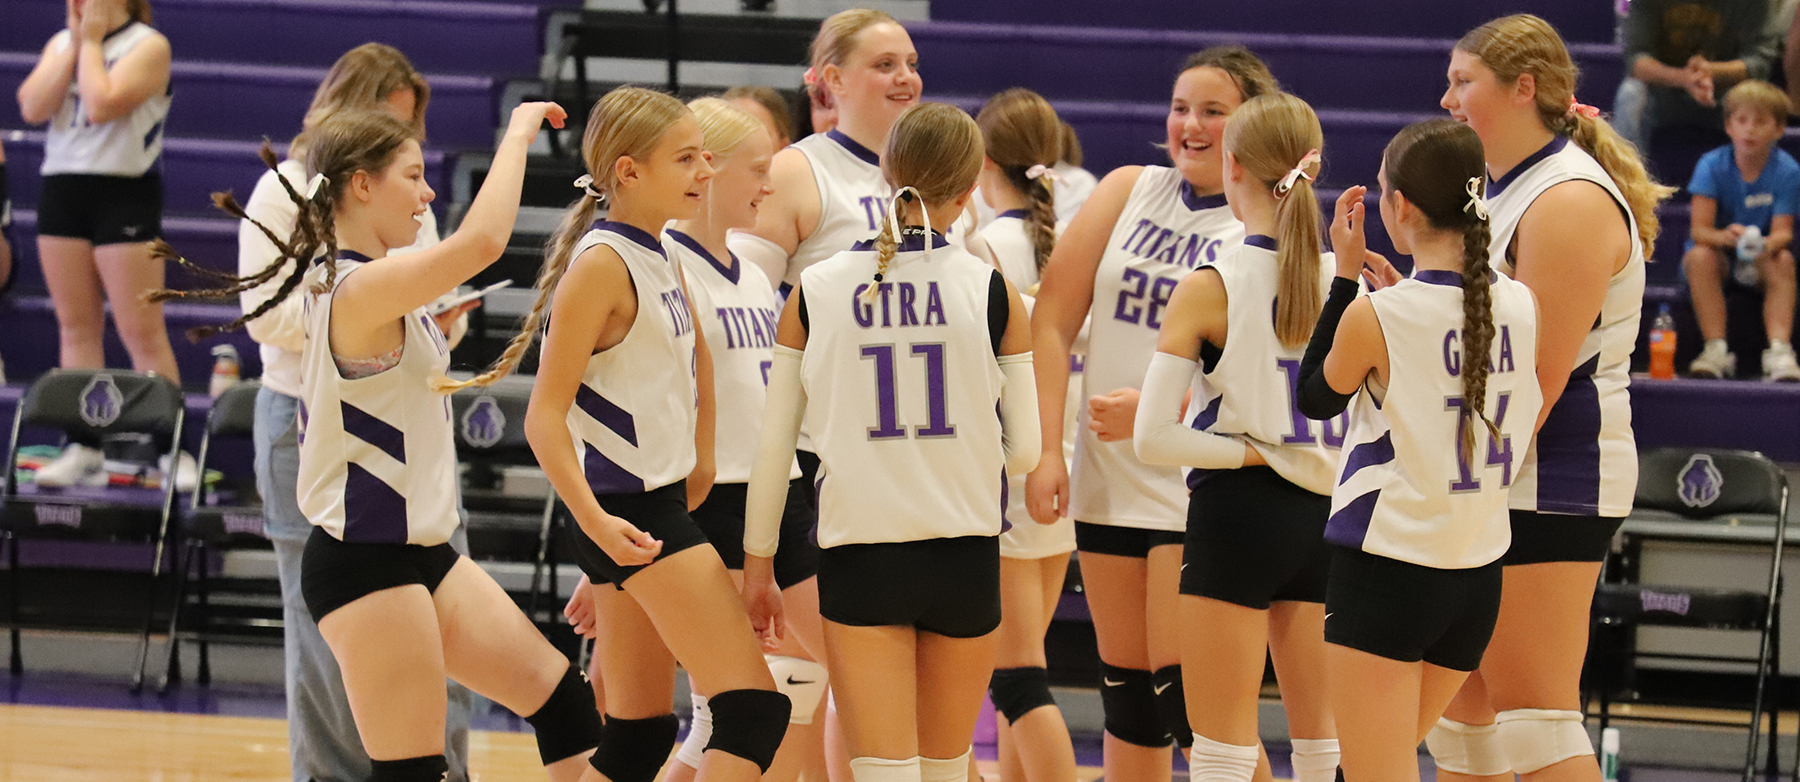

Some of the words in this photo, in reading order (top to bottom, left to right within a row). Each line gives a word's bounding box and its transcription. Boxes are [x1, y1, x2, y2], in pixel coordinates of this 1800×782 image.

[1121, 218, 1222, 269] TITANS
[716, 306, 778, 350] TITAN
[851, 281, 948, 329] GTRA
[859, 341, 958, 442] 11
[1443, 390, 1514, 495] 14
